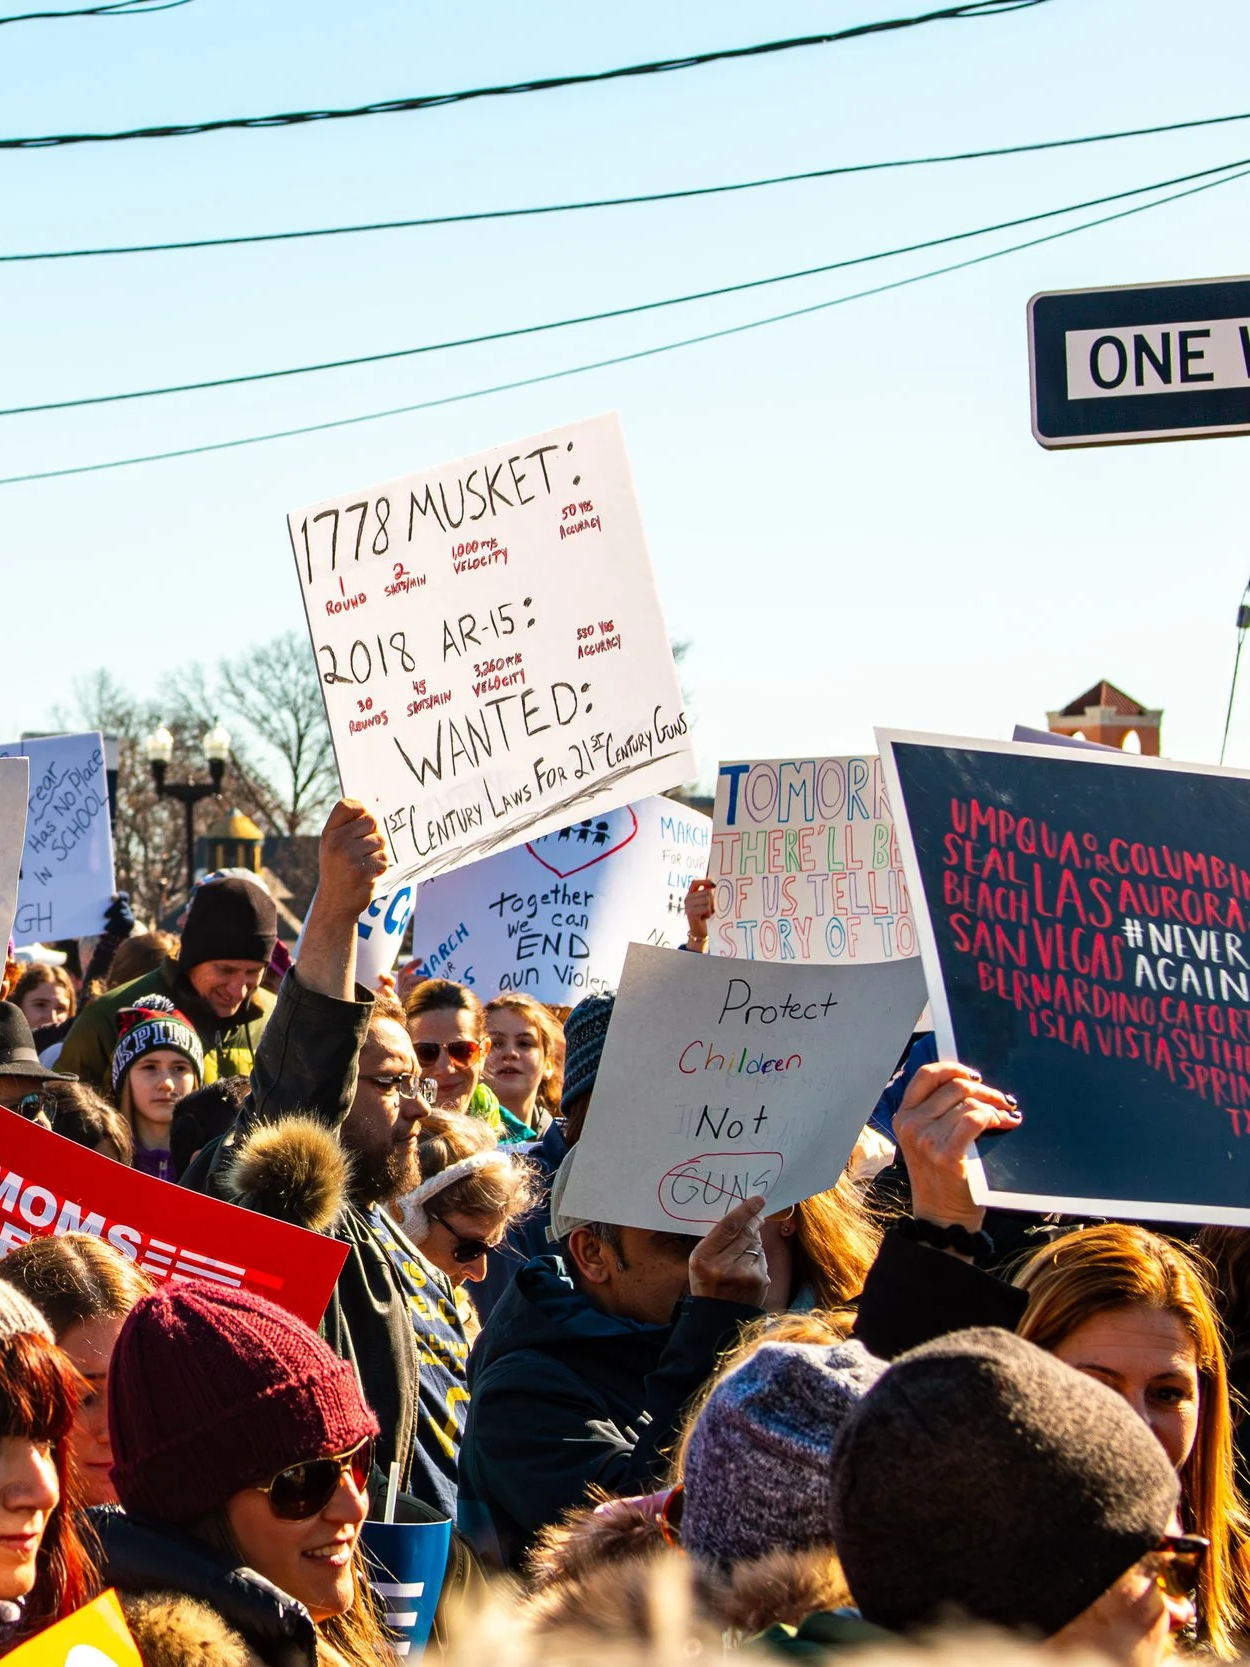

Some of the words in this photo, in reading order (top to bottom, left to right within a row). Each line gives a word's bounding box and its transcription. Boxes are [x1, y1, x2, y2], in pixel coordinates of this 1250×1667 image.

[1090, 329, 1214, 389] ONE
[301, 497, 390, 584] 1778
[408, 441, 581, 542] MUSKET:
[560, 515, 601, 540] ACCURACY
[562, 503, 576, 520] 50
[452, 540, 478, 560] 1,000
[453, 547, 508, 575] VELOCITY
[339, 576, 345, 597] 1
[384, 574, 426, 597] SHOTS/MIN
[393, 563, 410, 580] 2
[325, 592, 367, 616] ROUND
[319, 631, 416, 684] 2018
[443, 597, 536, 662] AR-15:
[578, 634, 621, 659] ACCURACY
[412, 679, 426, 695] 45
[472, 668, 525, 697] VELOCITY
[357, 697, 373, 712] 30
[407, 690, 451, 717] SHOTS/MIN
[349, 711, 388, 736] ROUNDS
[393, 682, 594, 788] WANTED:
[68, 748, 103, 796] Place
[410, 801, 482, 856] CENTURY
[483, 778, 532, 819] LAWS
[533, 757, 568, 796] FOR
[606, 729, 652, 769] CENTURY
[654, 705, 688, 744] GUNS
[51, 788, 109, 862] SCHOOL
[660, 816, 709, 848] MARCH
[662, 848, 682, 865] FOR
[686, 855, 707, 871] OUR
[712, 824, 863, 876] THERE'LL
[942, 833, 1029, 885] SEAL
[667, 871, 699, 889] LIVE
[714, 877, 753, 920] OF
[762, 875, 798, 917] US
[944, 870, 1028, 925] BEACH
[1034, 862, 1113, 928] LAS
[489, 883, 594, 918] together
[551, 912, 589, 931] can
[719, 917, 812, 961] STORY
[826, 916, 862, 958] OF
[415, 922, 470, 978] MARCH
[516, 931, 590, 961] END
[950, 913, 1026, 967] SAN
[1032, 918, 1125, 982] VEGAS
[1121, 918, 1250, 970] #NEVER
[1135, 954, 1250, 1002] AGAIN
[718, 978, 838, 1025] Protect
[1160, 996, 1191, 1028] CA
[1029, 1009, 1090, 1055] ISLA
[1092, 1022, 1176, 1083] VISTA
[695, 1104, 768, 1139] Not
[671, 1166, 772, 1214] GUNS
